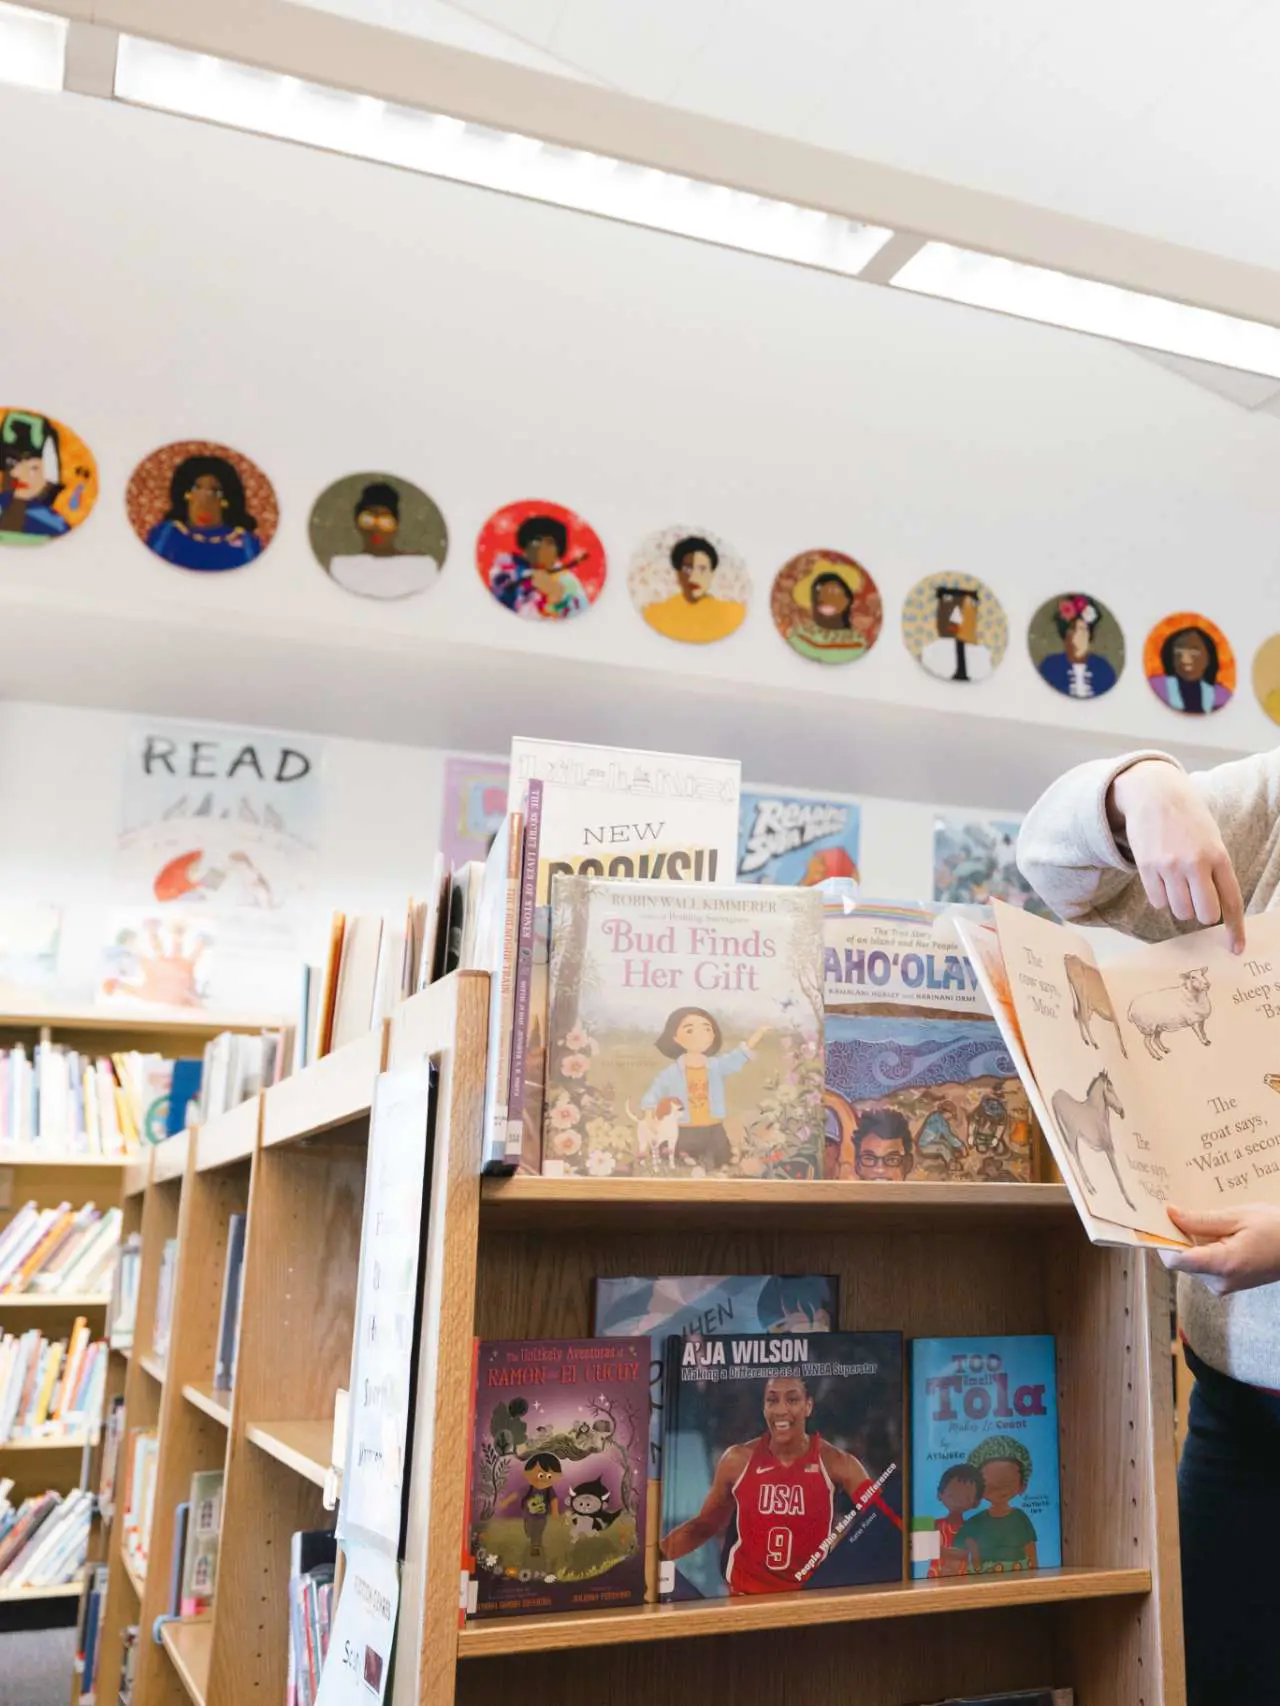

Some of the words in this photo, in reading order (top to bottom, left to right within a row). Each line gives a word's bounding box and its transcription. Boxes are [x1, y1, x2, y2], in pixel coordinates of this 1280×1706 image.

[143, 735, 310, 782] READ
[530, 790, 541, 808] THE
[528, 813, 539, 847] SECRET
[583, 822, 665, 845] NEW
[526, 852, 536, 879] LIVES
[525, 883, 534, 895] OF
[612, 893, 660, 909] ROBIN
[660, 896, 702, 911] WALL
[703, 898, 777, 913] KIMMERER
[522, 901, 533, 938] STONES
[602, 918, 675, 954] Bud
[688, 927, 776, 958] Finds
[622, 959, 684, 988] Her
[694, 961, 760, 991] Gift
[1243, 959, 1273, 977] The
[1232, 982, 1271, 1005] sheep
[1207, 1096, 1238, 1115] The
[1200, 1124, 1233, 1149] goat
[1235, 1114, 1268, 1134] says,
[1234, 1149, 1243, 1160] a
[1215, 1175, 1225, 1193] I
[1227, 1171, 1250, 1189] say
[521, 1347, 563, 1362] Unlikely
[731, 1338, 809, 1364] WILSON
[585, 1361, 640, 1382] CUCUY
[681, 1367, 720, 1382] Making
[729, 1366, 778, 1380] Difference
[780, 1369, 793, 1378] as
[802, 1363, 832, 1377] WNBA
[833, 1361, 878, 1378] Superstar
[951, 1353, 1003, 1374] TOO
[926, 1372, 1047, 1421] Tola
[996, 1420, 1027, 1430] Count
[758, 1484, 806, 1515] USA
[795, 1551, 821, 1581] People
[819, 1532, 837, 1551] Who
[835, 1509, 857, 1533] Make
[860, 1462, 897, 1504] Difference
[765, 1527, 794, 1571] 9
